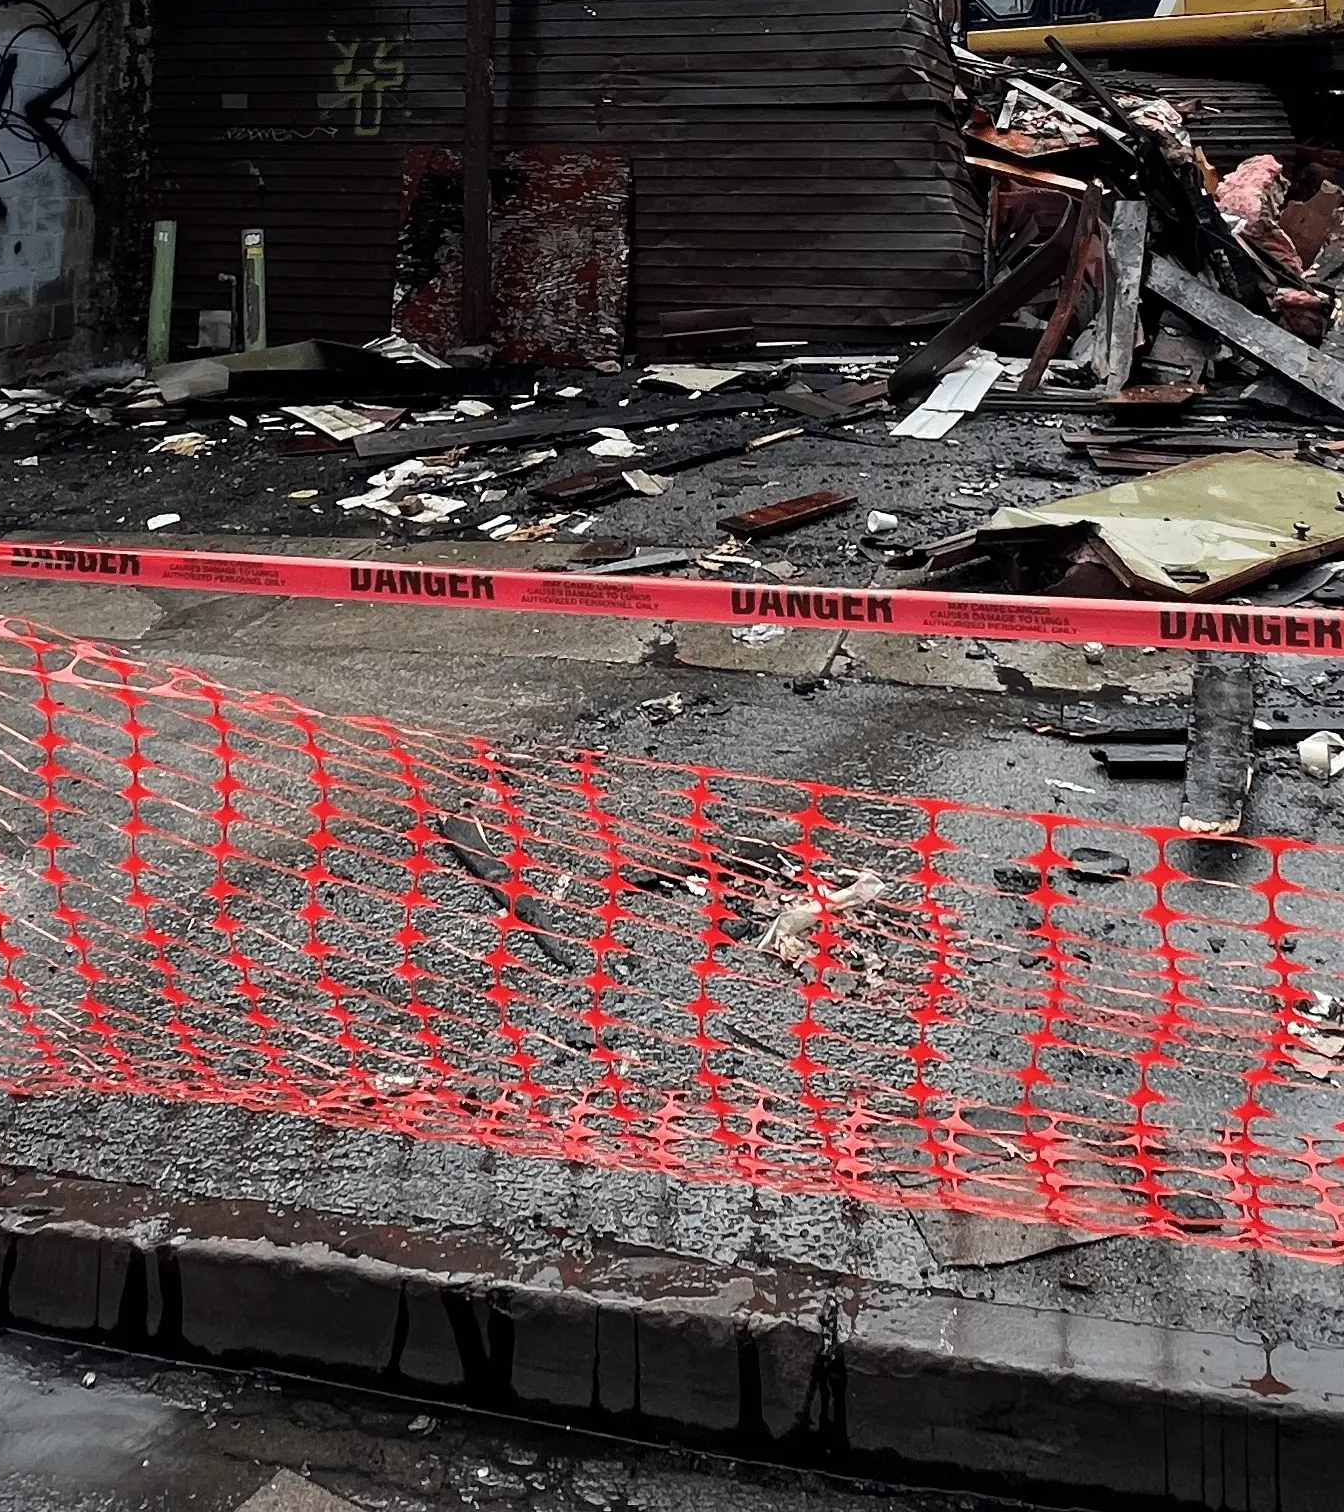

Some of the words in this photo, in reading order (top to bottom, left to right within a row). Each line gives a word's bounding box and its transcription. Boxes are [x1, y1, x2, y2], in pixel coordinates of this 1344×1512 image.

[350, 567, 495, 600] DANGER
[731, 588, 893, 623] DANGER
[1160, 611, 1343, 649] DANGER
